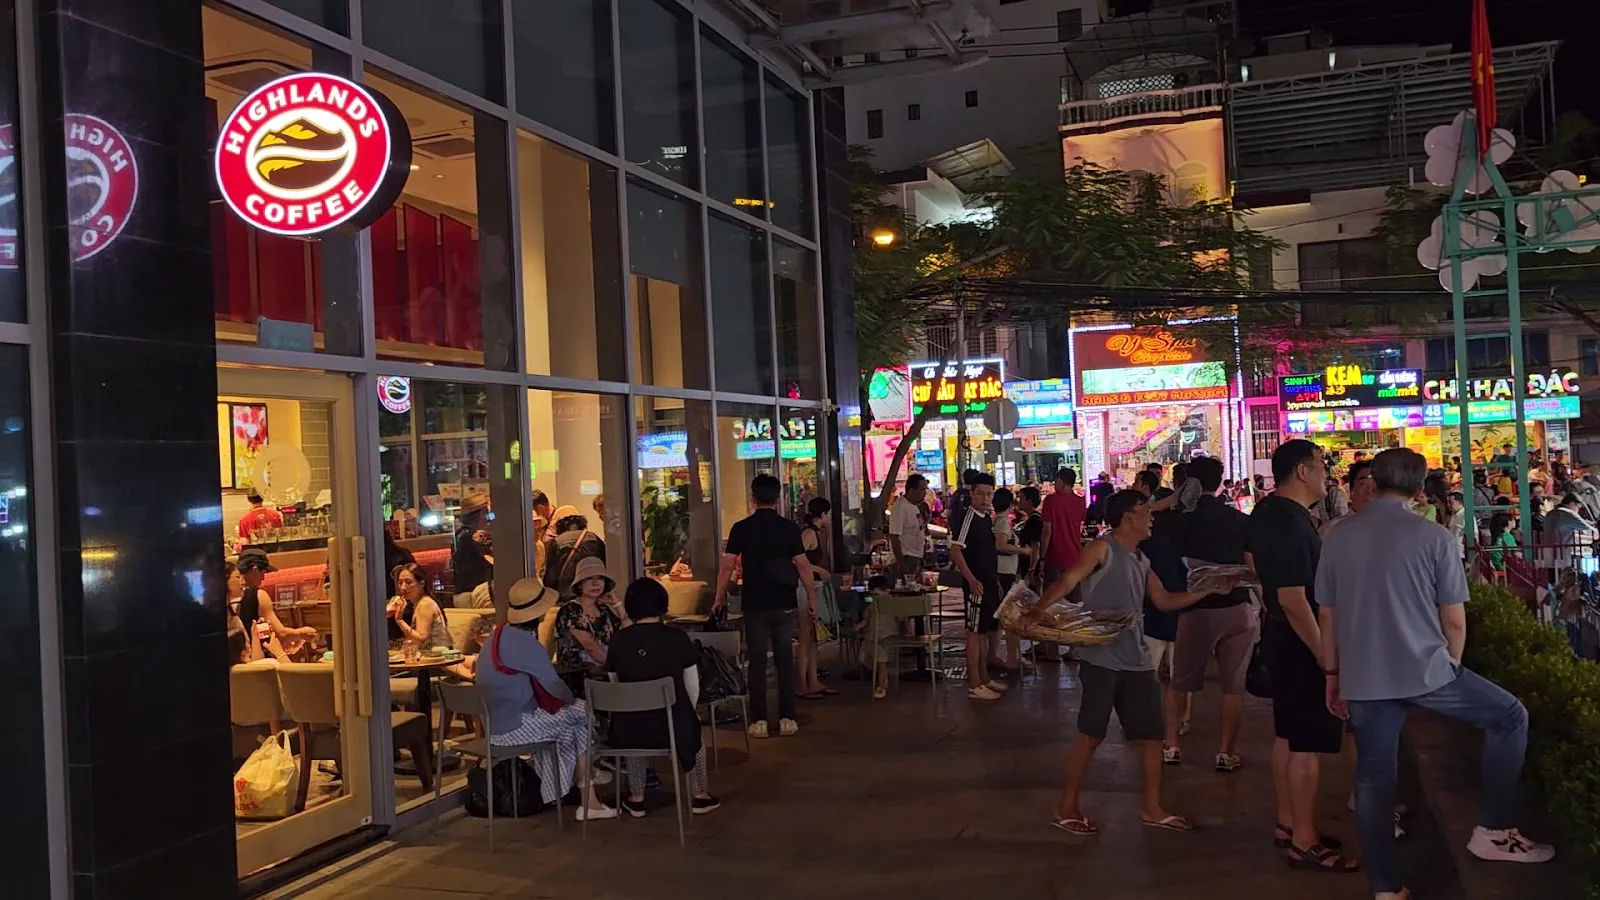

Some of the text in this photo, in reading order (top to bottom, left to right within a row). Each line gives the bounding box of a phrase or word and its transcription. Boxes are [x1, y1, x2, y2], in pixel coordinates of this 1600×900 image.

[225, 84, 378, 155] HIGHLANDS
[245, 180, 364, 225] COFFEE
[1326, 365, 1362, 385] KEM
[1083, 394, 1117, 405] NAILS
[1135, 391, 1168, 402] FOOT
[1425, 404, 1441, 417] 48
